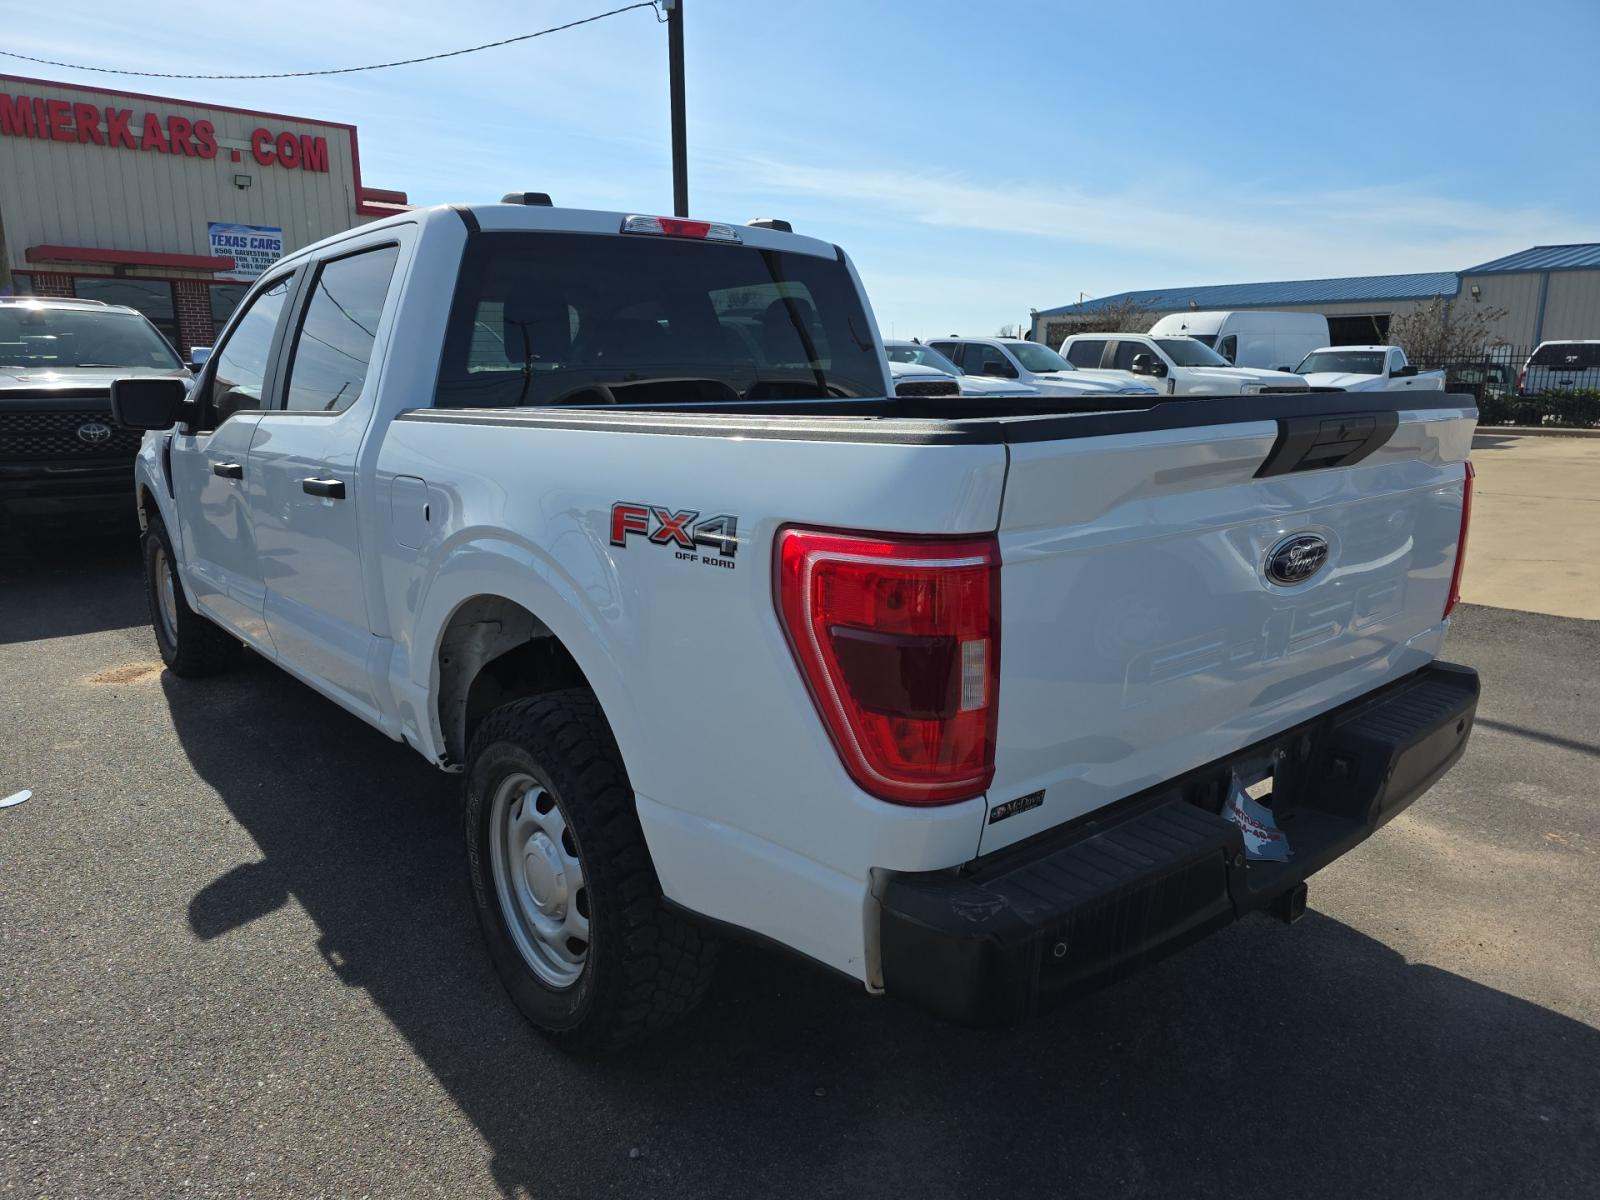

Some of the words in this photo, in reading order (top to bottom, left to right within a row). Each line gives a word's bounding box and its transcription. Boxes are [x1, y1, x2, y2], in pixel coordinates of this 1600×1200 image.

[211, 234, 247, 248] TEXAS
[250, 237, 281, 251] CARS
[610, 501, 738, 557] FX4
[675, 551, 699, 562] OFF
[702, 556, 735, 569] ROAD
